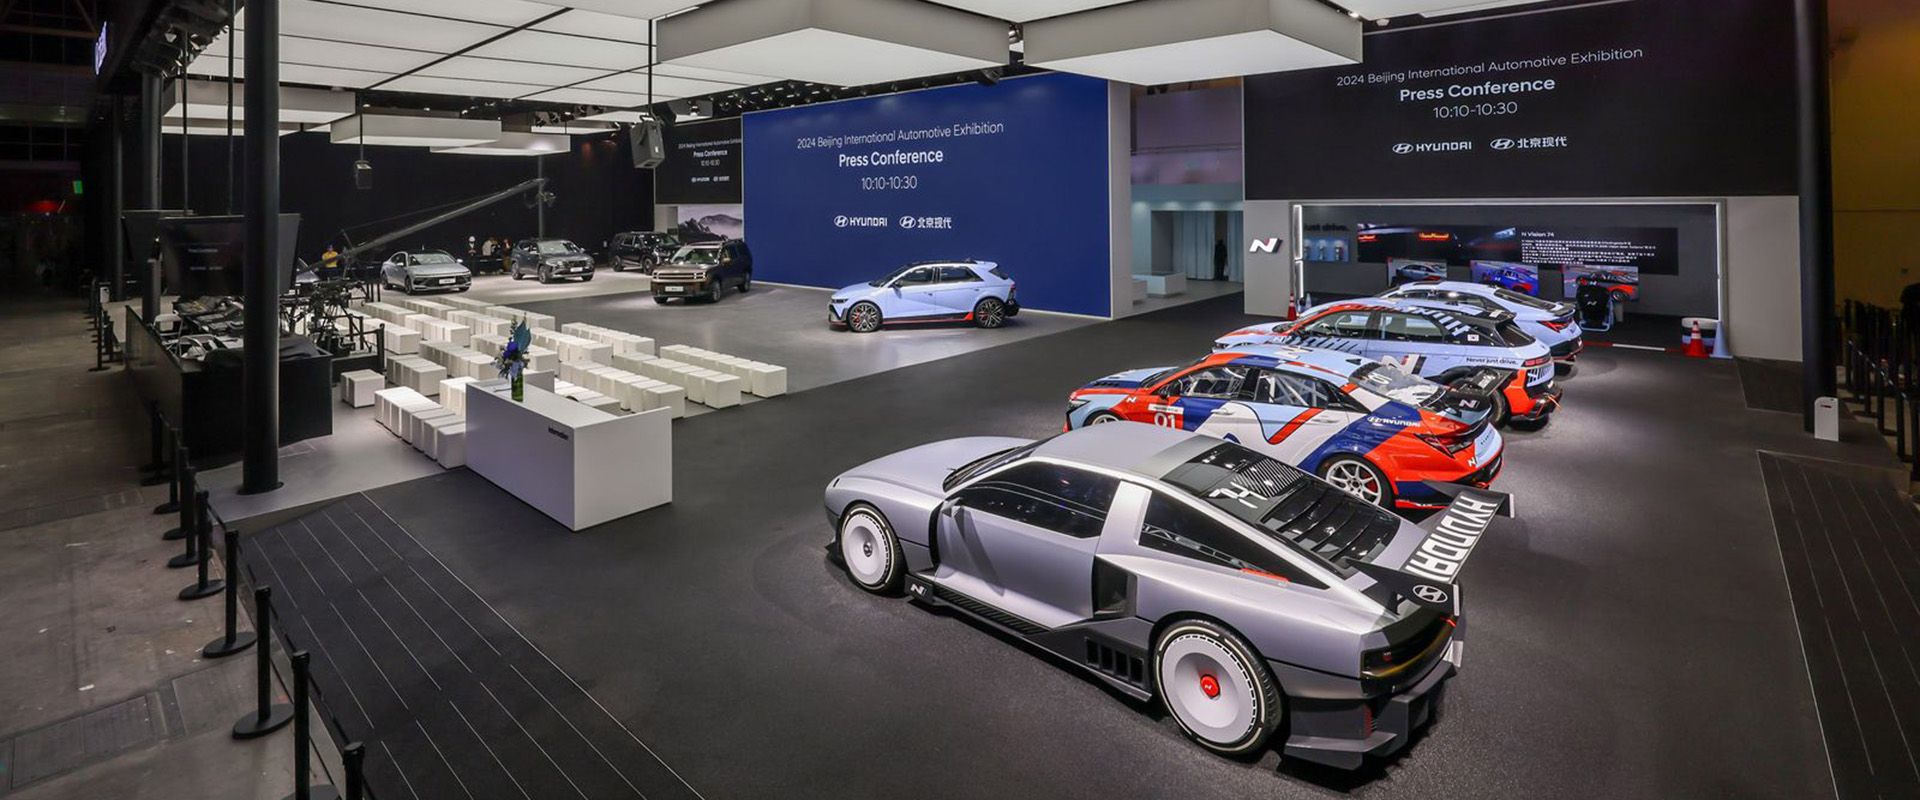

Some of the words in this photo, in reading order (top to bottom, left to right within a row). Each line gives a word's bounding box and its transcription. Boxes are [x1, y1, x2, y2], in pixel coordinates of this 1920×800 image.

[1336, 74, 1365, 87] 2024
[1368, 71, 1405, 84] Beijing
[1408, 62, 1485, 80] International
[1488, 55, 1567, 72] Automotive
[1571, 48, 1643, 64] Exhibition
[1400, 87, 1444, 101] Press
[1448, 78, 1556, 97] Conference
[1433, 101, 1518, 119] 10:10-10:30
[797, 137, 816, 150] 2024
[818, 135, 843, 148] Beijing
[844, 130, 896, 145] International
[898, 126, 951, 141] Automotive
[953, 121, 1004, 137] Exhibition
[1517, 136, 1568, 149] 北京现代
[1416, 141, 1472, 152] HYUNDAI
[839, 153, 869, 168] Press
[870, 149, 944, 166] Conference
[861, 175, 918, 191] 10:10-10:30
[849, 216, 888, 227] HYUNDAI
[917, 216, 953, 229] 北京现代
[1466, 356, 1486, 364] Never
[1486, 357, 1499, 365] just
[1154, 412, 1176, 428] 01
[1404, 495, 1498, 582] HYUNDAI
